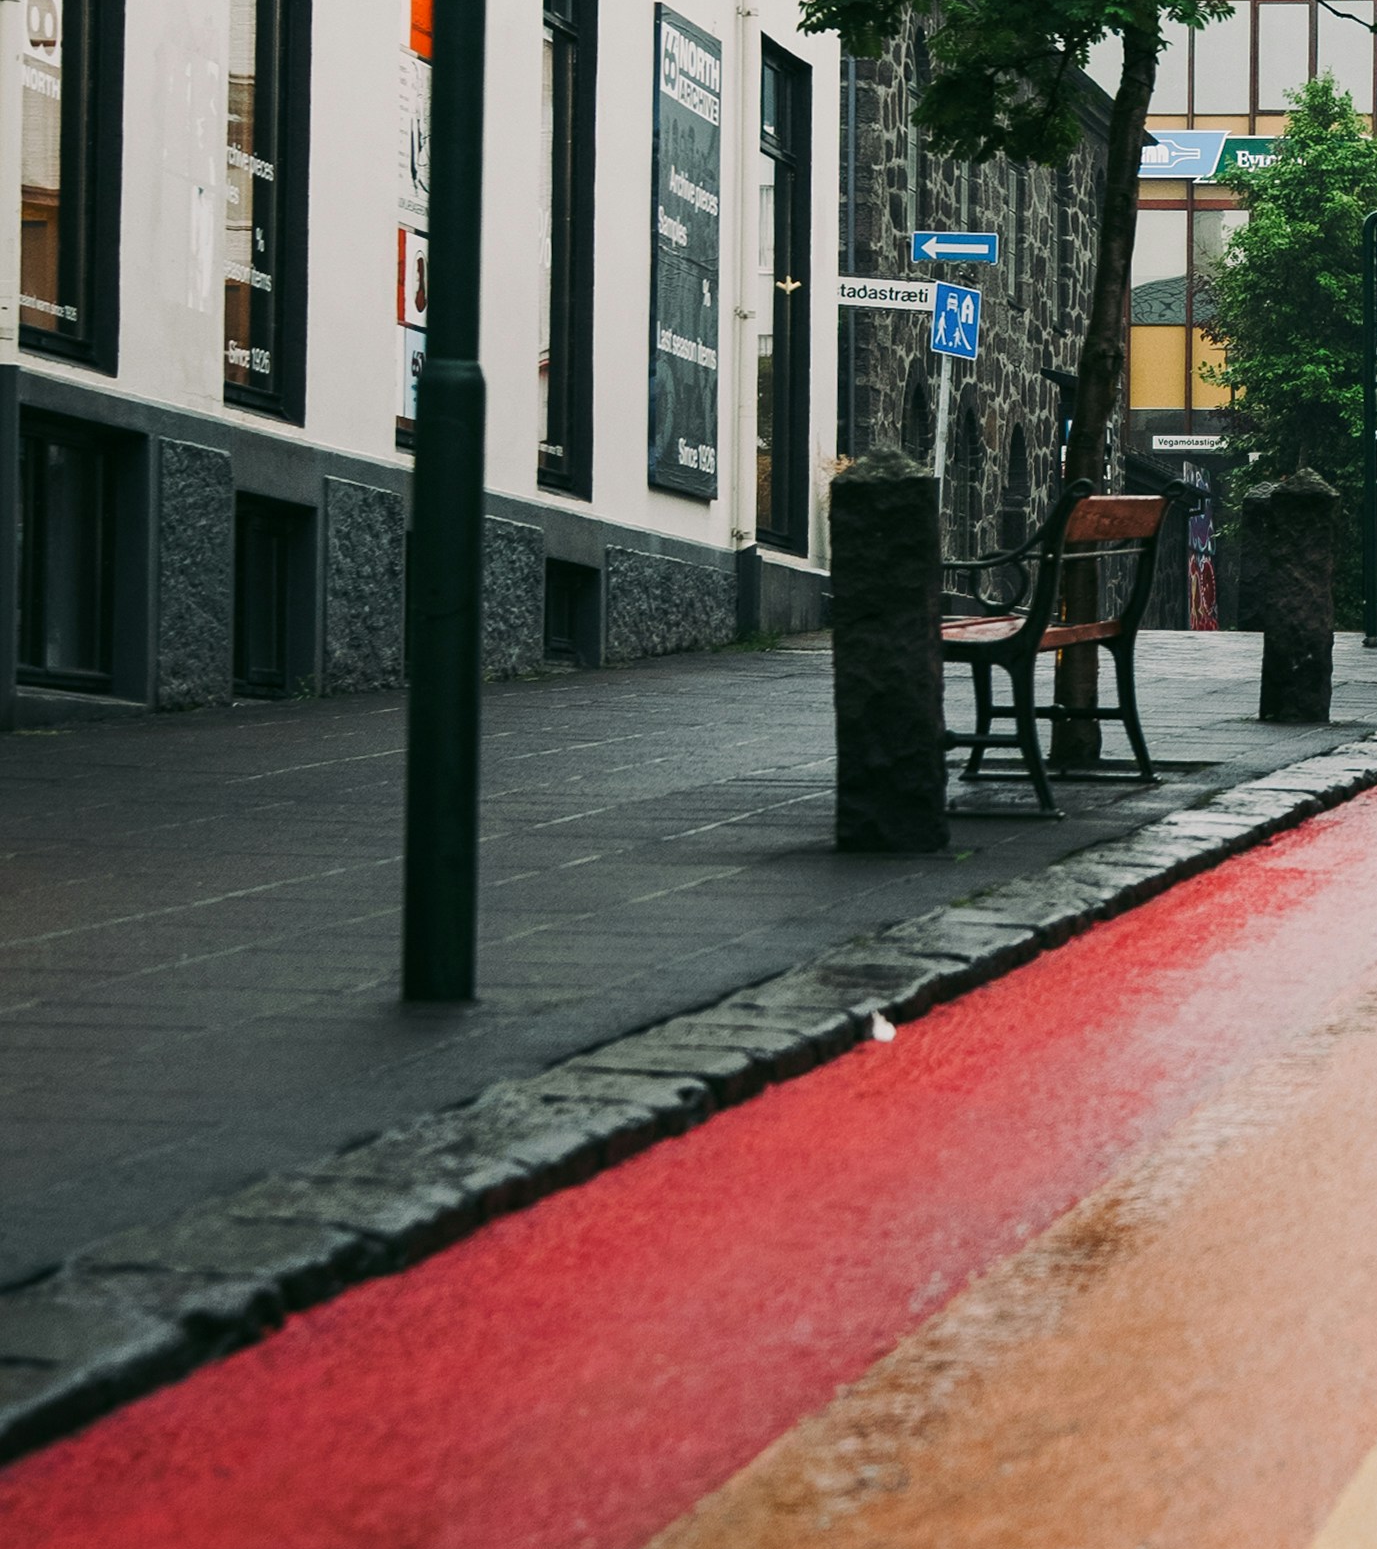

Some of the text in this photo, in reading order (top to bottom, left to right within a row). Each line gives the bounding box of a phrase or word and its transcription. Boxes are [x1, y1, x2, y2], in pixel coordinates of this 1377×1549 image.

[679, 34, 721, 93] NORTH
[680, 77, 720, 123] ARCHIVE
[838, 284, 929, 304] taðastræti
